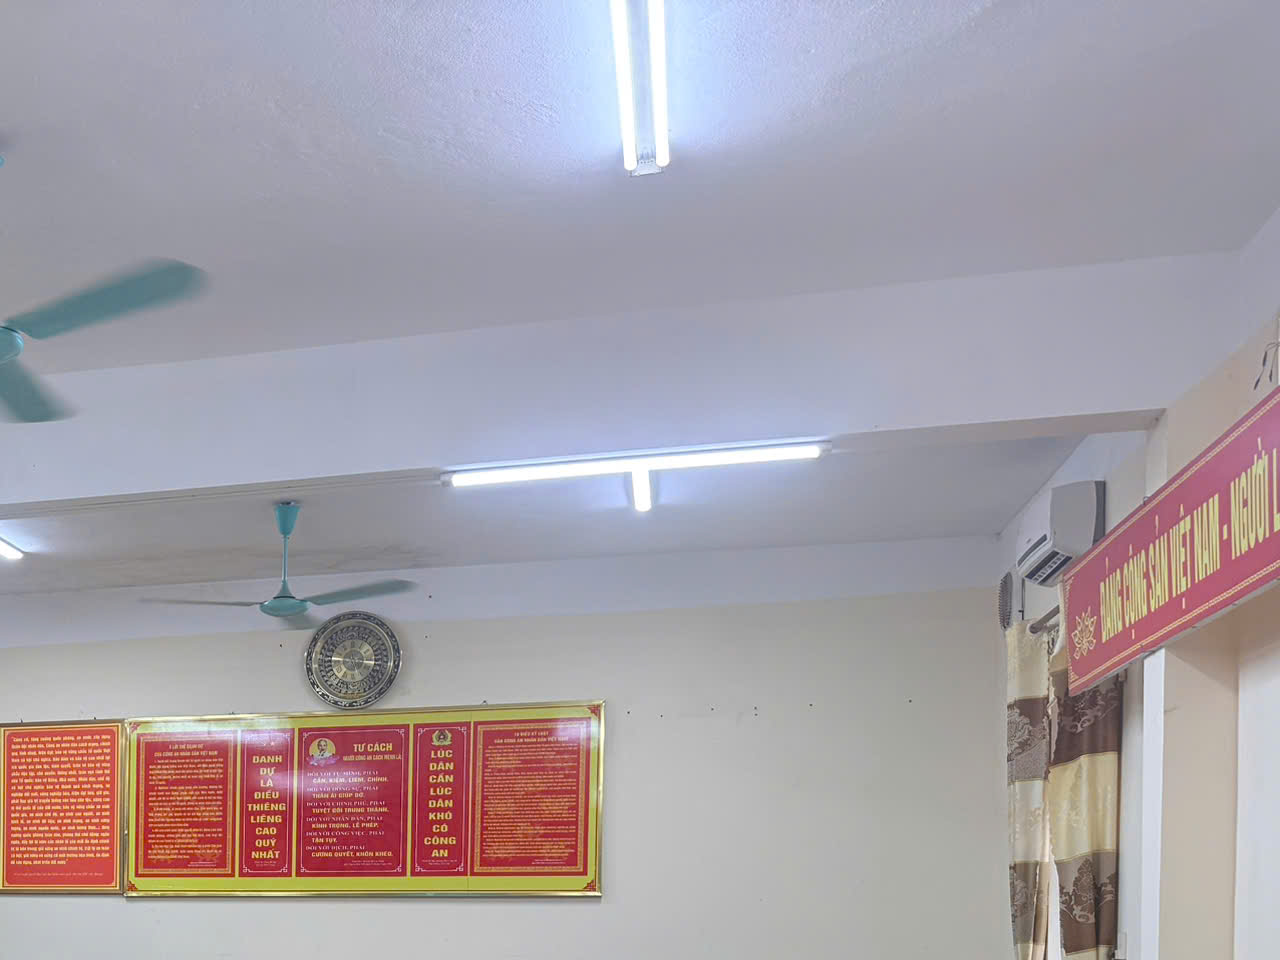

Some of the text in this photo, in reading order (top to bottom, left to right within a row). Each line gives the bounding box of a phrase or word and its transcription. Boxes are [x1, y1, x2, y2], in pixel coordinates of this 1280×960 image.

[1123, 544, 1147, 639] CỘNG
[1149, 515, 1169, 613] SẢN
[1170, 504, 1192, 609] VIỆT
[1194, 493, 1220, 583] NAM
[1230, 437, 1270, 560] NGƯỜI
[367, 742, 393, 752] CÁCH
[431, 748, 453, 758] LÚC
[252, 755, 283, 764] DANH
[429, 761, 454, 770] DÂN
[260, 766, 276, 776] DỰ
[430, 785, 452, 795] LÚC
[247, 802, 286, 811] THIÊNG
[429, 798, 453, 808] DÂN
[250, 814, 282, 823] LIÊNG
[428, 810, 453, 820] KHÓ
[255, 827, 277, 835] CAO
[432, 823, 448, 833] CÓ
[424, 835, 457, 845] CÔNG
[251, 848, 280, 859] NHẤT
[432, 849, 448, 857] AN
